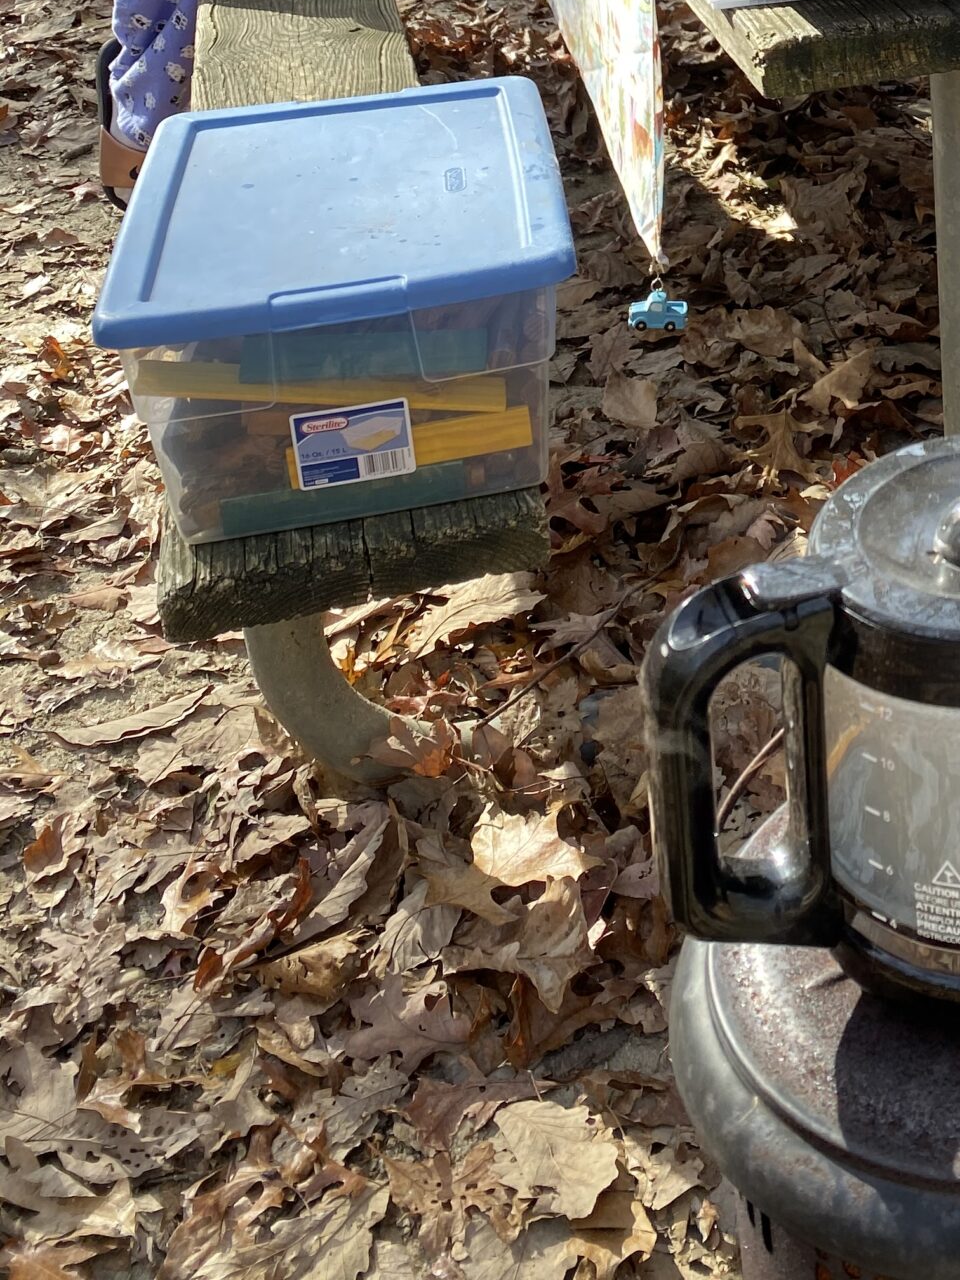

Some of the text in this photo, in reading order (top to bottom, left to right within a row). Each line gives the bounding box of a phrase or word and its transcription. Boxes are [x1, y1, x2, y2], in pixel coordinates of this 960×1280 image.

[306, 420, 341, 432] Sterilite
[880, 757, 896, 772] 10
[883, 810, 891, 823] 8
[886, 864, 894, 877] 6
[914, 892, 949, 906] BEFORE
[888, 918, 898, 930] 4
